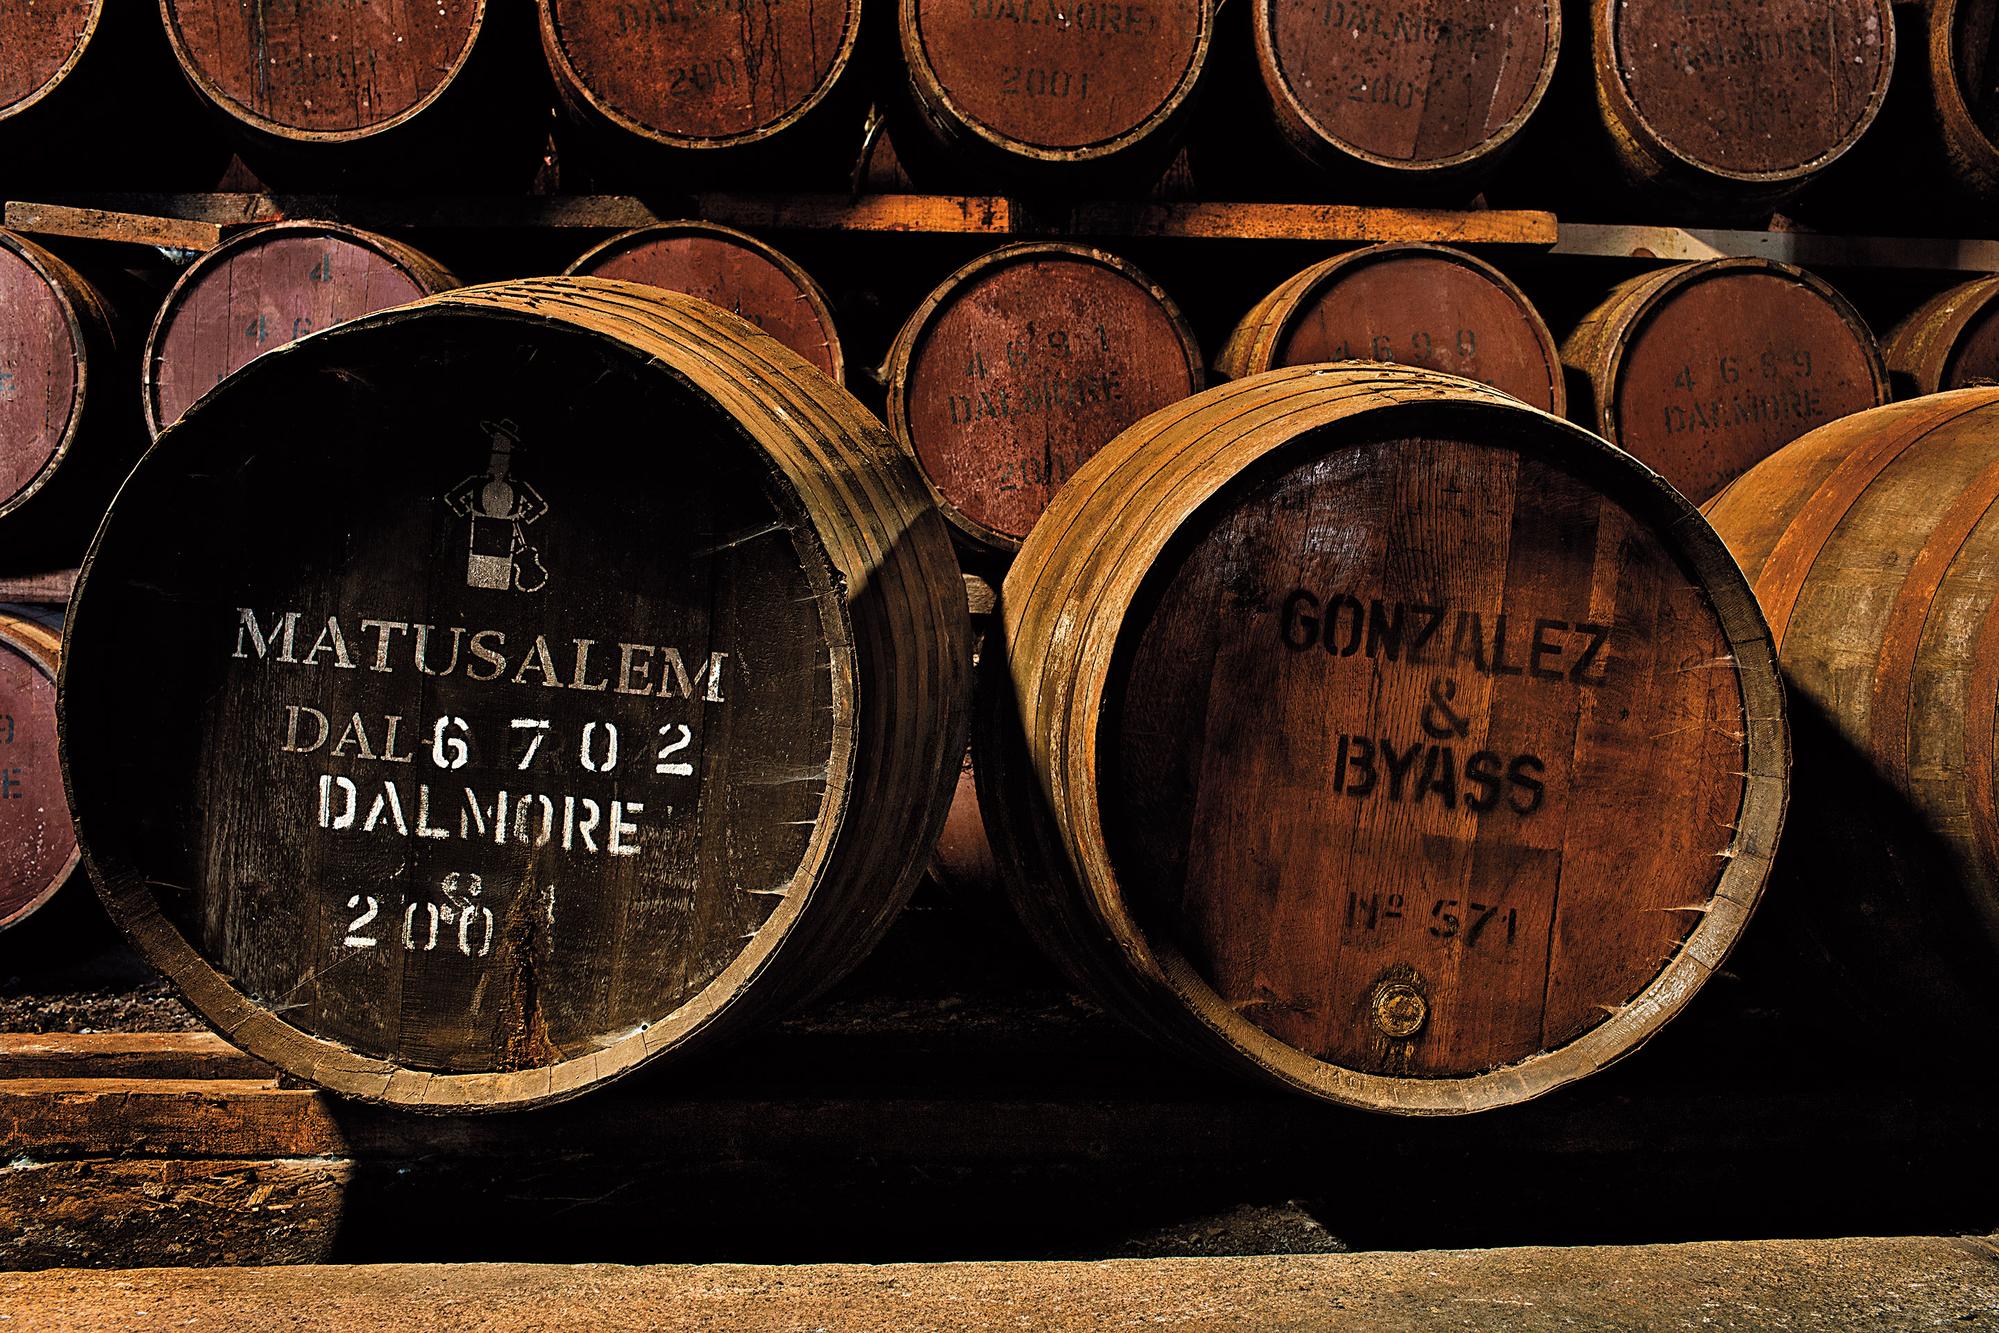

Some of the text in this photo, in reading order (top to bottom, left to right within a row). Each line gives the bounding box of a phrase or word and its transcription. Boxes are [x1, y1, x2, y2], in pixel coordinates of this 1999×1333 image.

[1001, 65, 1089, 100] 2001
[309, 254, 332, 282] 4
[231, 606, 730, 703] MATUSALEM
[1281, 588, 1609, 687] GONZALEZ
[1421, 677, 1469, 740] &
[1333, 733, 1545, 815] BYASS
[318, 774, 645, 857] DALMORE
[1429, 899, 1518, 949] 571
